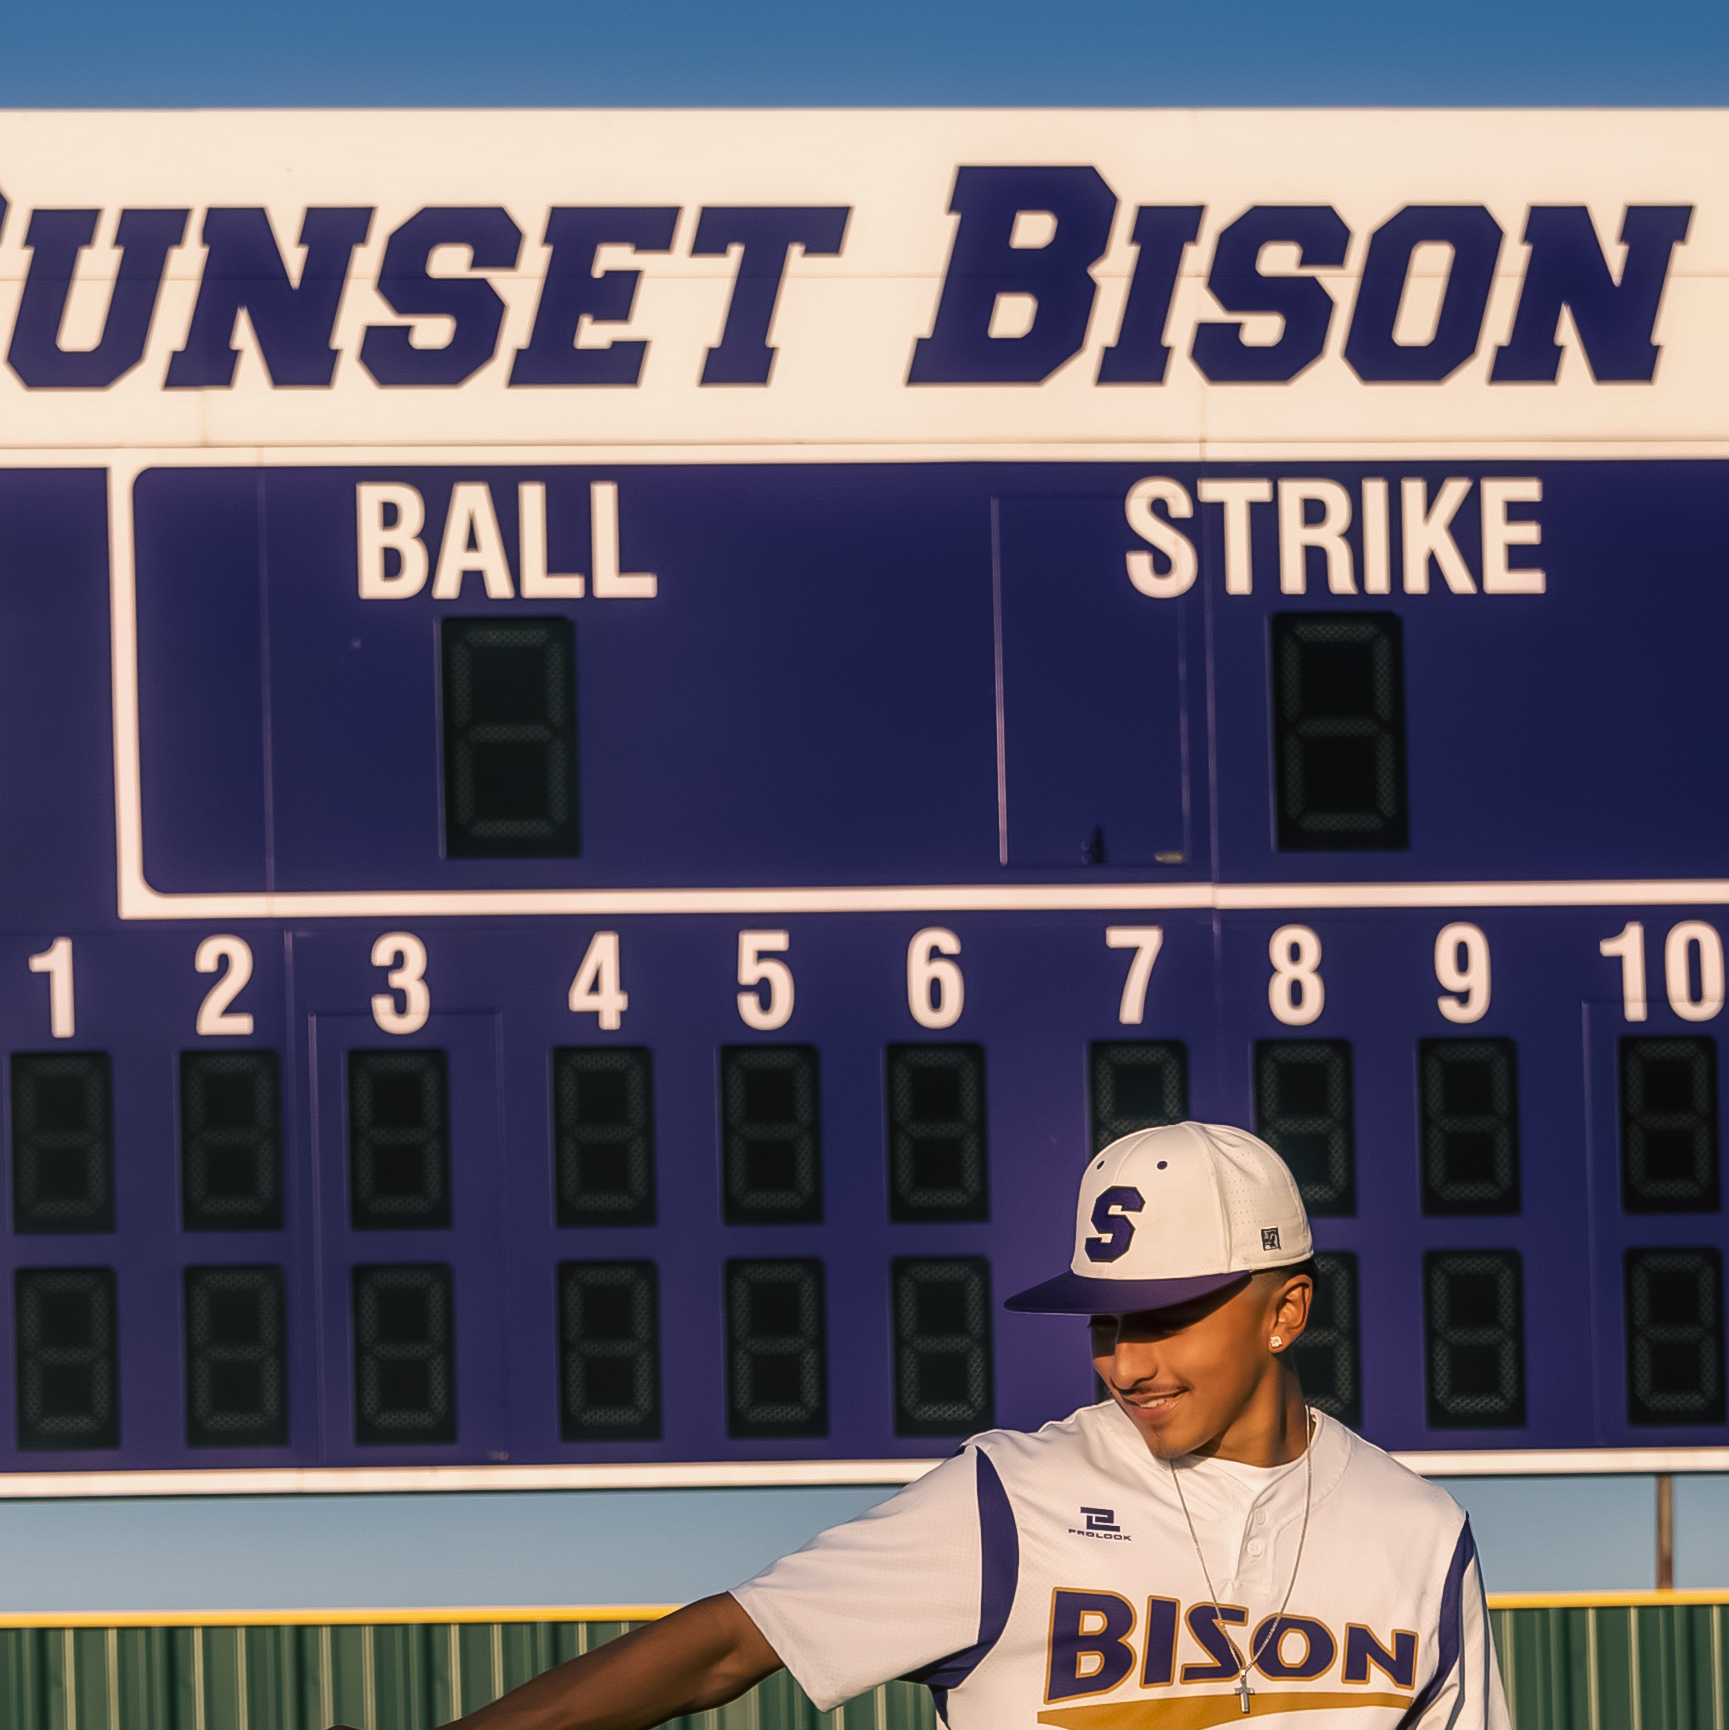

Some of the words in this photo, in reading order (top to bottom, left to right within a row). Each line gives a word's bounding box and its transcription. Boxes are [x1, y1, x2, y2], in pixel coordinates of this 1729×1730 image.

[905, 165, 1696, 387] BISON
[355, 480, 659, 601] BALL
[1124, 475, 1547, 600] STRIKE
[28, 936, 75, 1038] 1
[194, 934, 255, 1036] 2
[370, 932, 431, 1035] 3
[568, 931, 629, 1031] 4
[736, 930, 795, 1031] 5
[907, 927, 965, 1029] 6
[1105, 926, 1164, 1025] 7
[1268, 924, 1325, 1026] 8
[1434, 922, 1492, 1024] 9
[1599, 920, 1726, 1022] 10
[1084, 1185, 1146, 1263] S
[1068, 1528, 1132, 1541] PROLOOK
[1044, 1585, 1419, 1705] BISON
